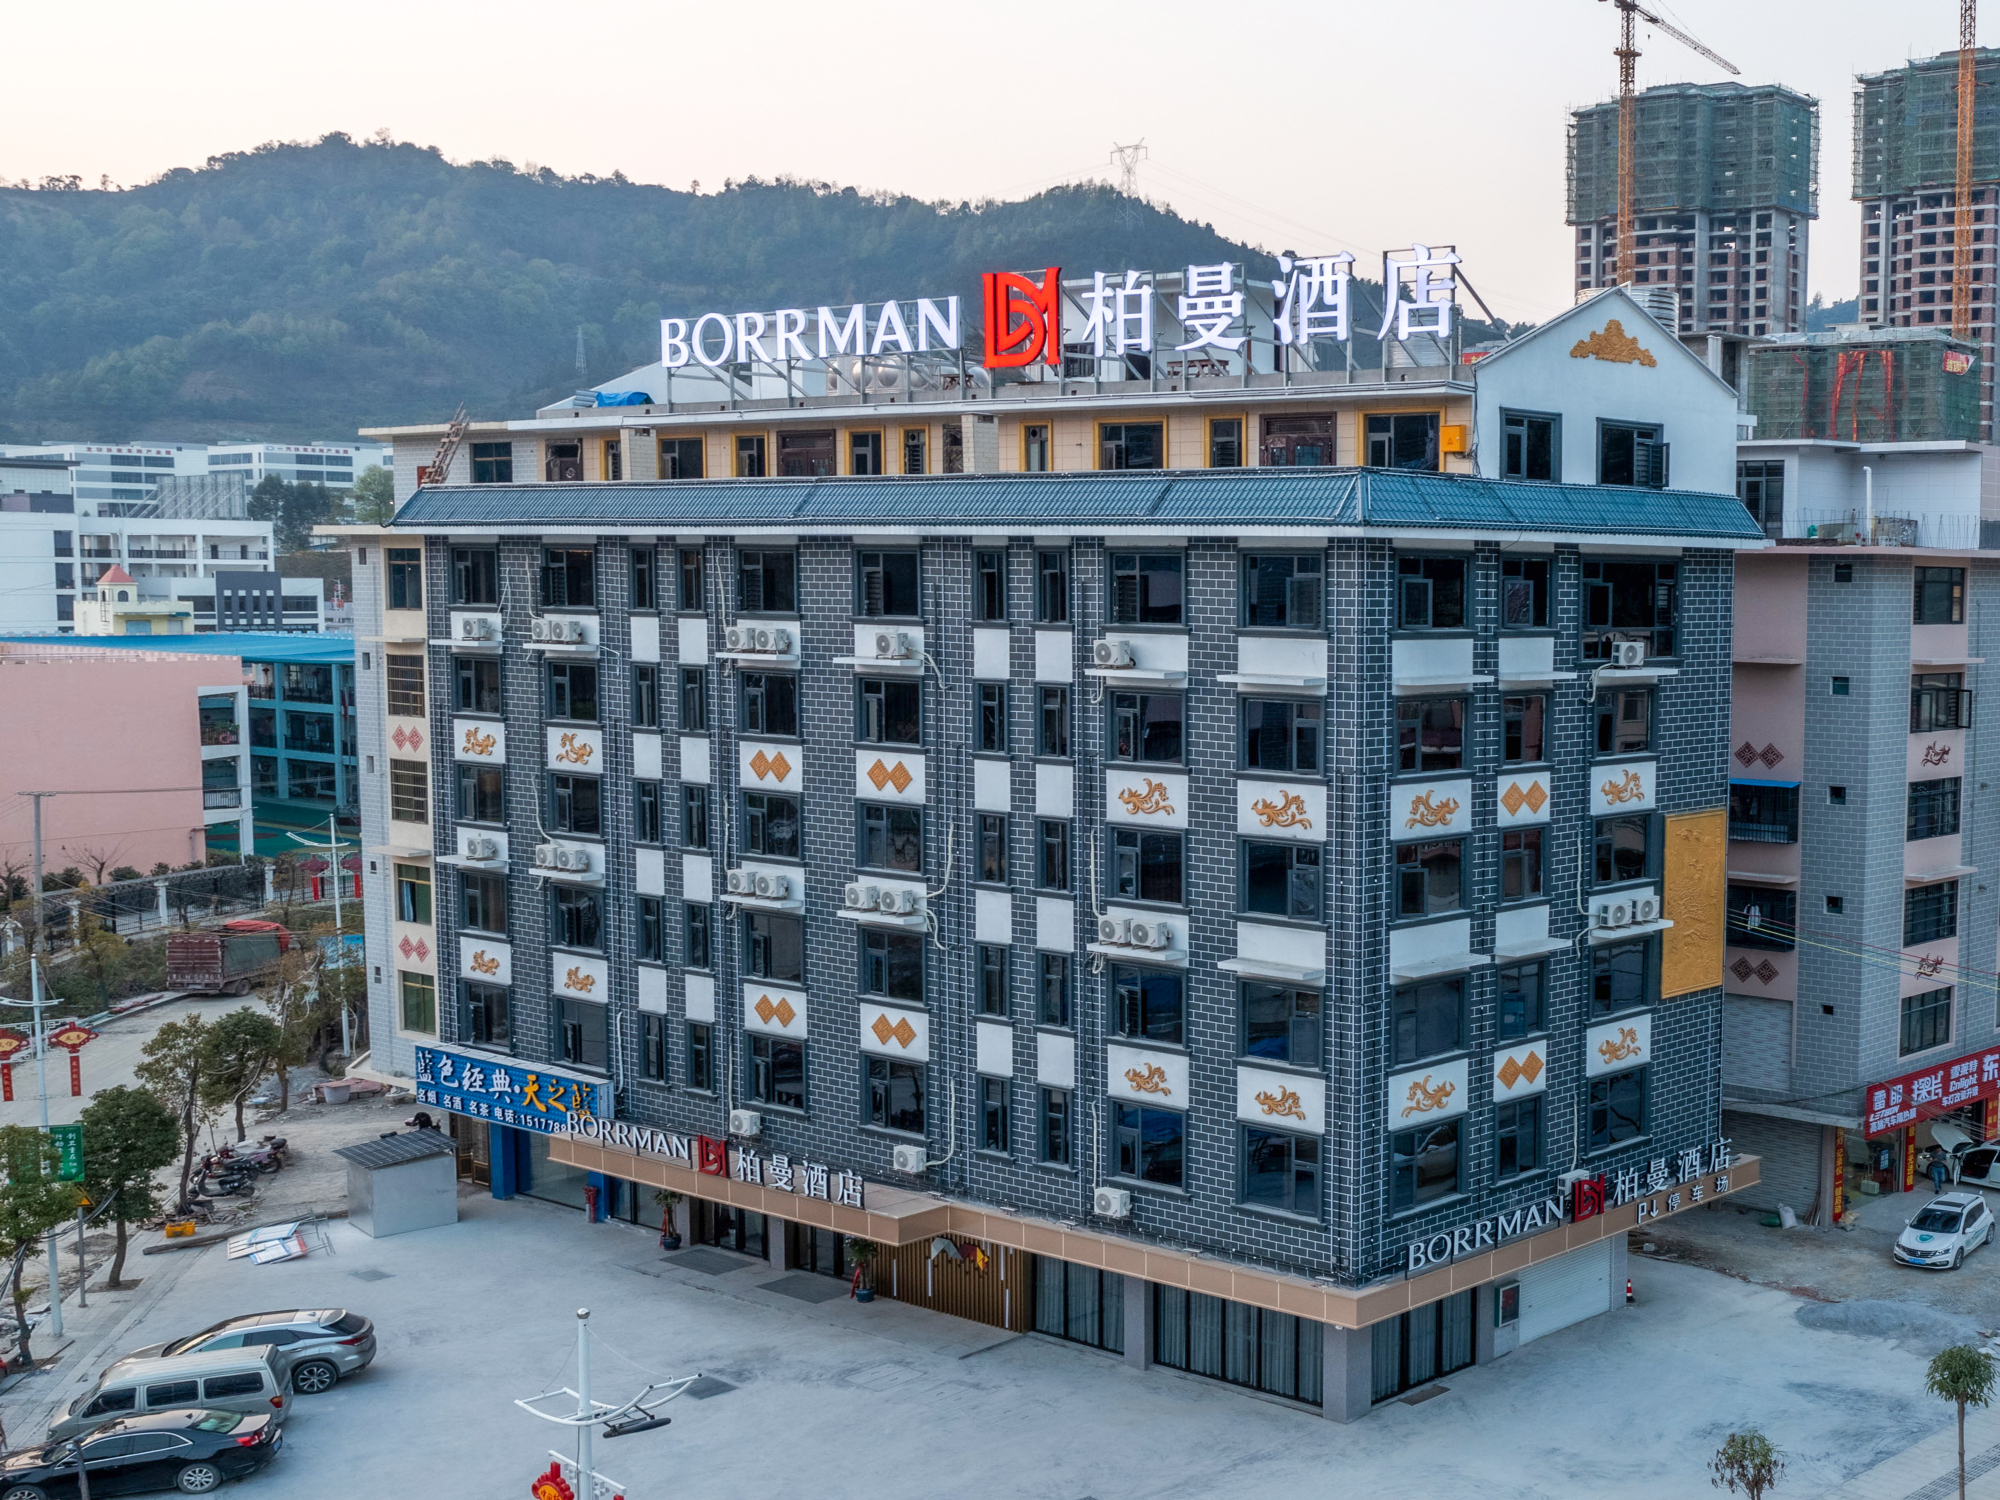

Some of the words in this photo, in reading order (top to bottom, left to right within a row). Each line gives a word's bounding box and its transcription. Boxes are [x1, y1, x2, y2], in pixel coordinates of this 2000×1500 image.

[660, 295, 961, 368] BORRMAN
[1082, 243, 1461, 358] 柏曼酒店
[417, 1088, 437, 1104] 名烟
[443, 1093, 462, 1110] 名酒
[469, 1099, 490, 1117] 名茶
[566, 1111, 691, 1160] BORRMAN
[735, 1145, 864, 1208] 柏曼酒店
[1407, 1195, 1565, 1272] BORRMAN
[1613, 1136, 1733, 1206] 柏曼酒店
[1668, 1175, 1729, 1212] 停车场
